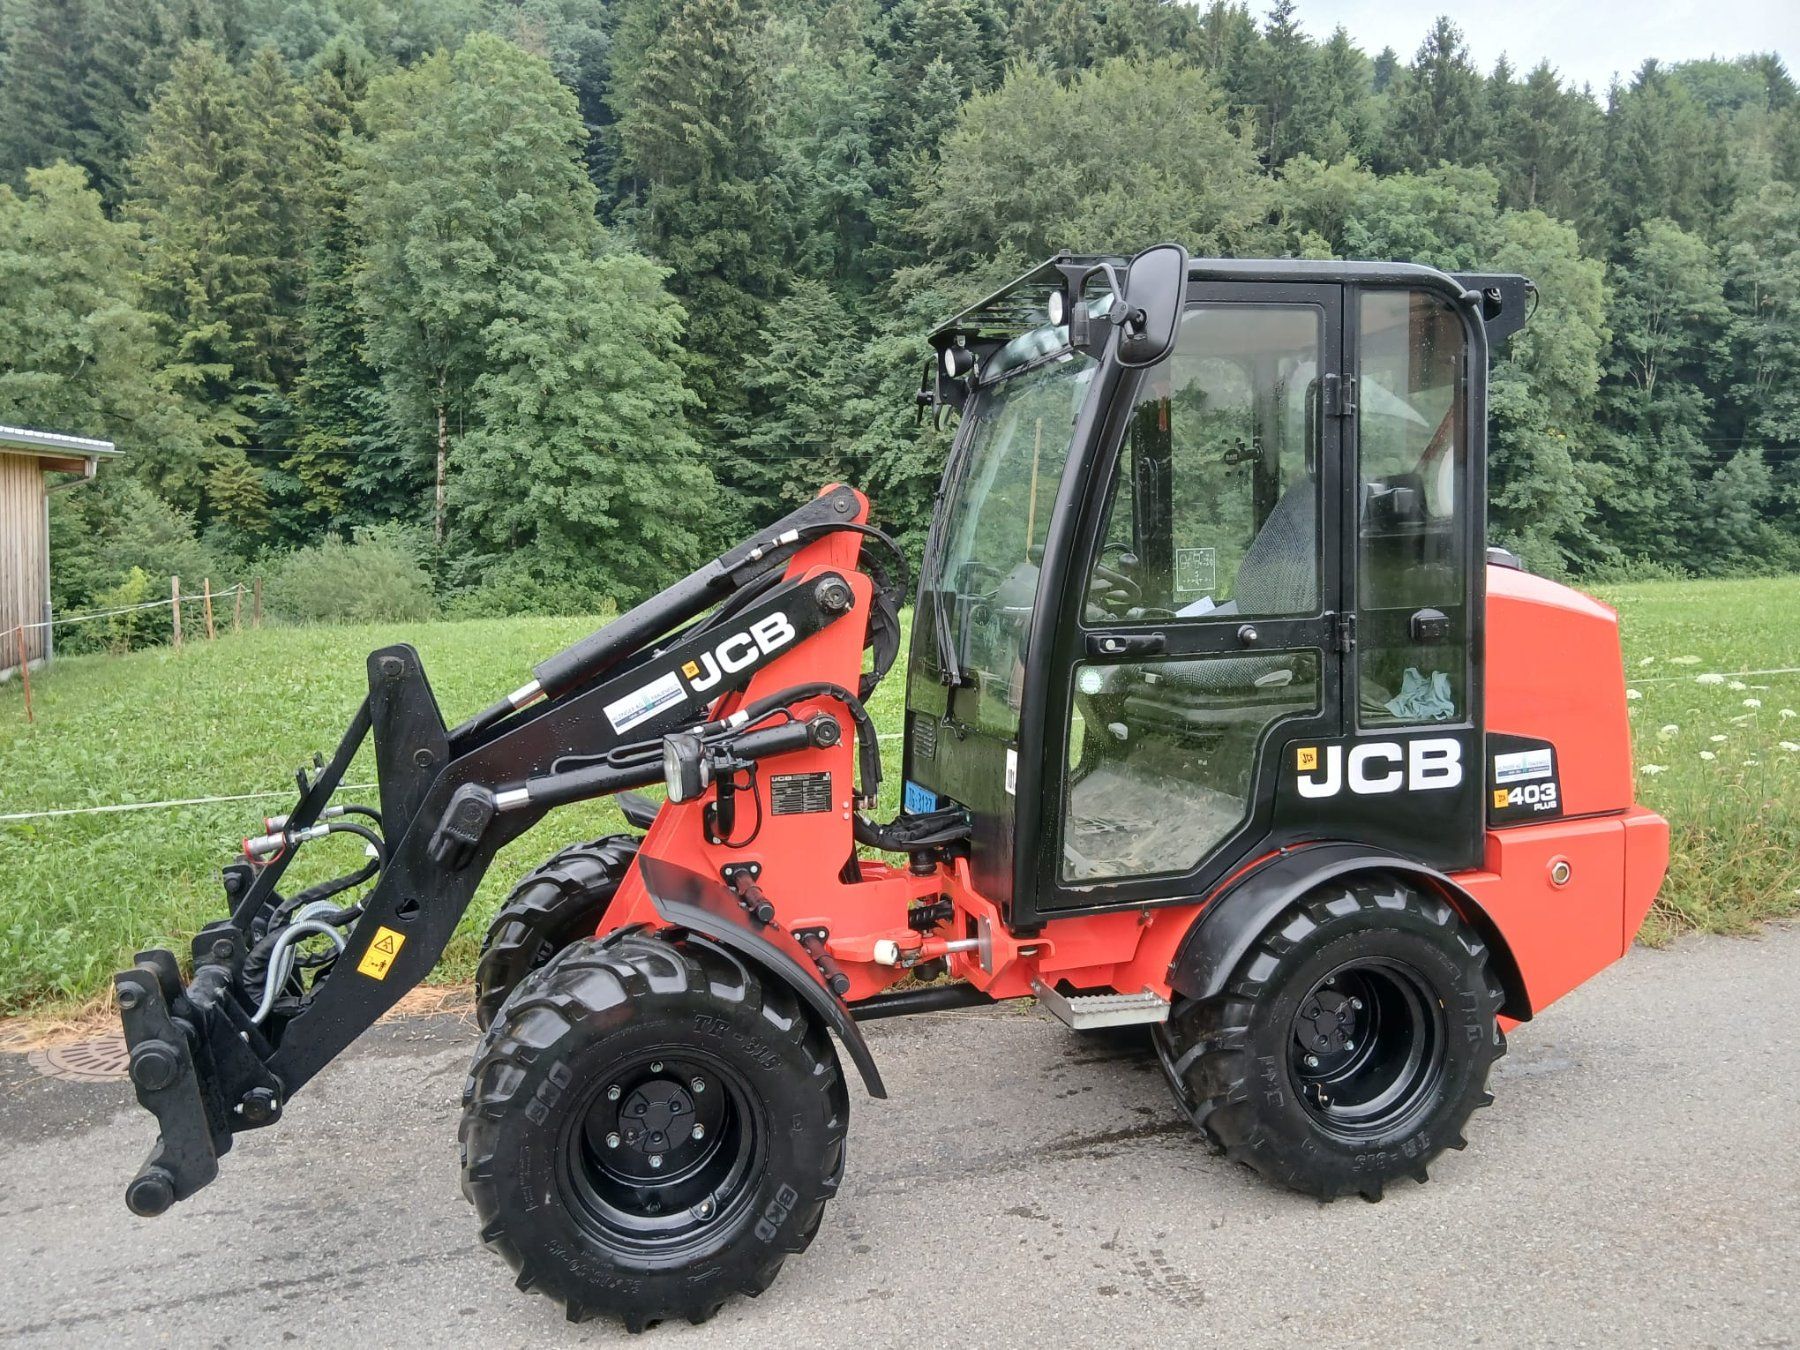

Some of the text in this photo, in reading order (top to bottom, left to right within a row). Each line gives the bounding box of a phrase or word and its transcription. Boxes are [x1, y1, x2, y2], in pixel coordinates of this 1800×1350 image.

[690, 611, 795, 691] JCB
[1297, 738, 1463, 798] JCB
[1508, 783, 1557, 806] 403
[1534, 801, 1557, 811] PLUS
[526, 1060, 573, 1126] BKT
